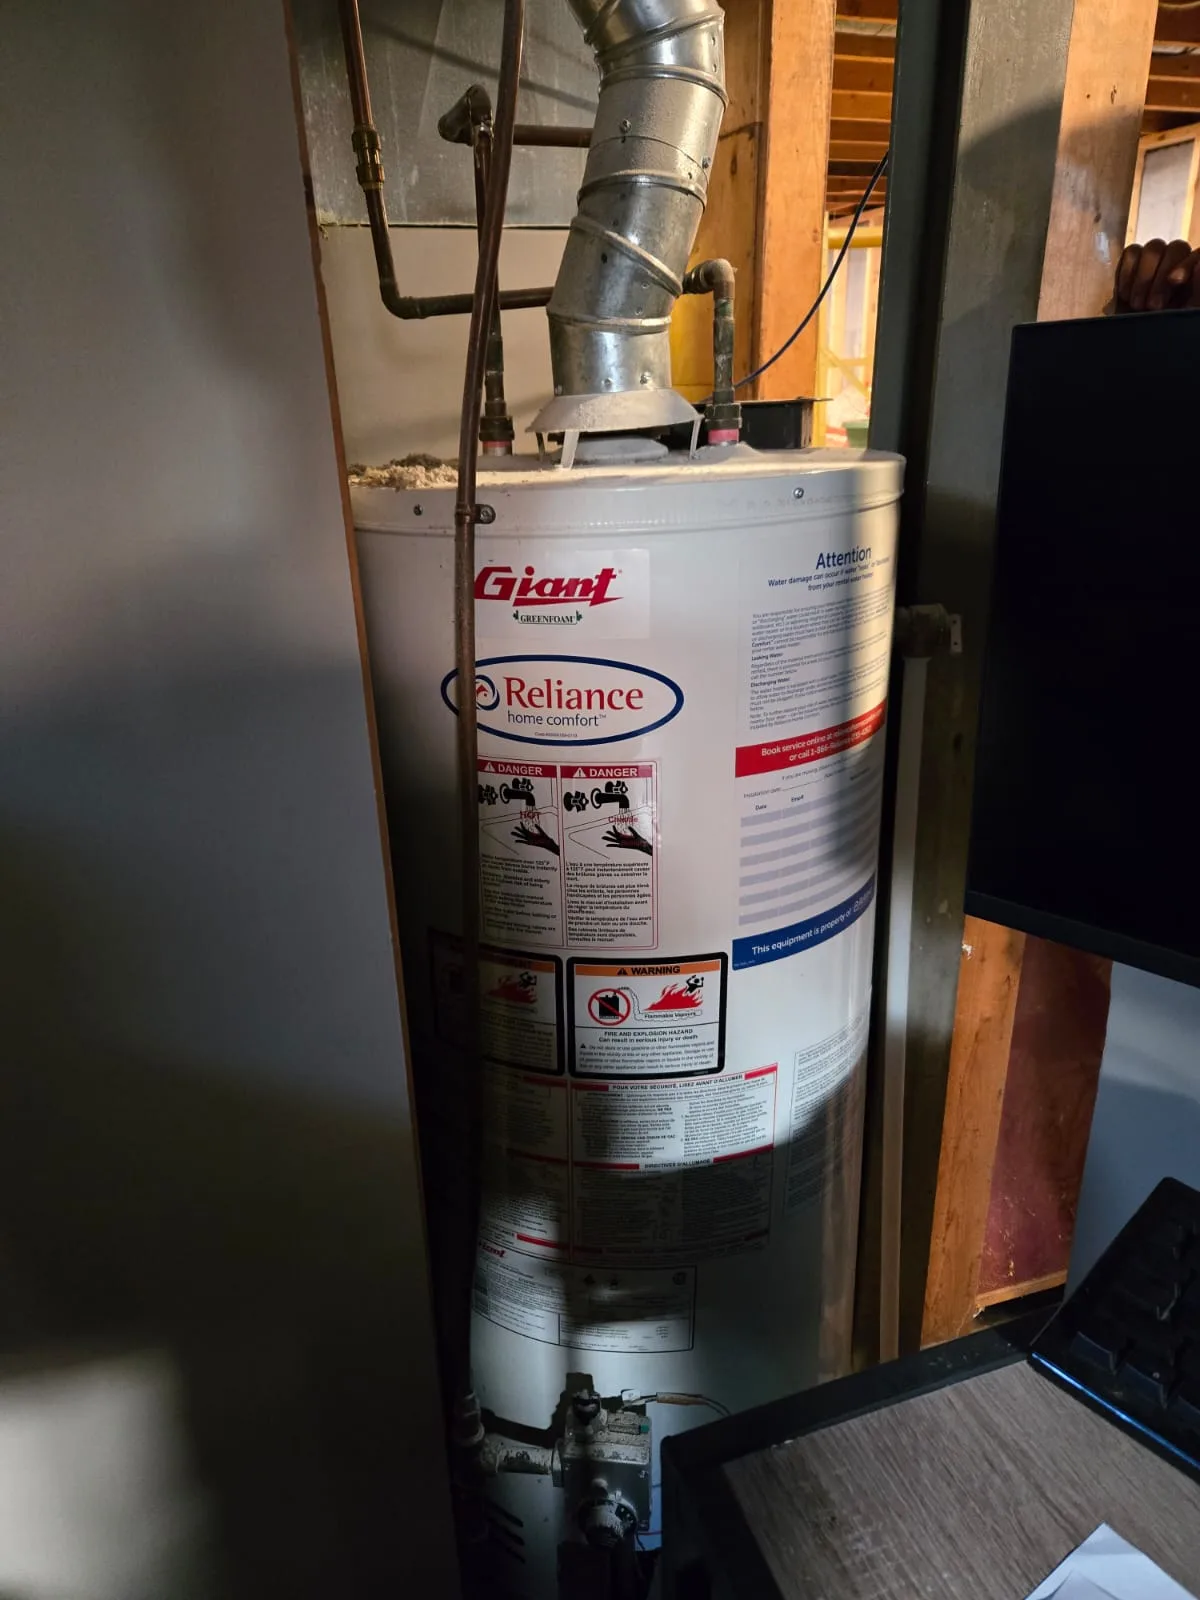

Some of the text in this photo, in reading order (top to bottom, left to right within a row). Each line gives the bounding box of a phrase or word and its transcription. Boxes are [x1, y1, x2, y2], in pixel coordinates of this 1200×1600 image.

[815, 546, 872, 569] Attention
[474, 565, 618, 607] Giant
[768, 578, 788, 587] Water
[788, 575, 813, 585] damage
[813, 573, 824, 581] can
[519, 613, 575, 624] GREENFOAM
[503, 676, 644, 711] Reliance
[508, 710, 543, 725] home
[761, 745, 782, 756] Book
[782, 741, 806, 753] service
[806, 735, 826, 746] online
[789, 750, 810, 762] or call
[498, 764, 543, 776] DANGER
[590, 767, 638, 777] DANGER
[751, 945, 770, 956] This
[771, 929, 814, 951] equipment
[813, 927, 820, 936] is
[820, 915, 845, 935] property
[632, 966, 681, 975] WARNING
